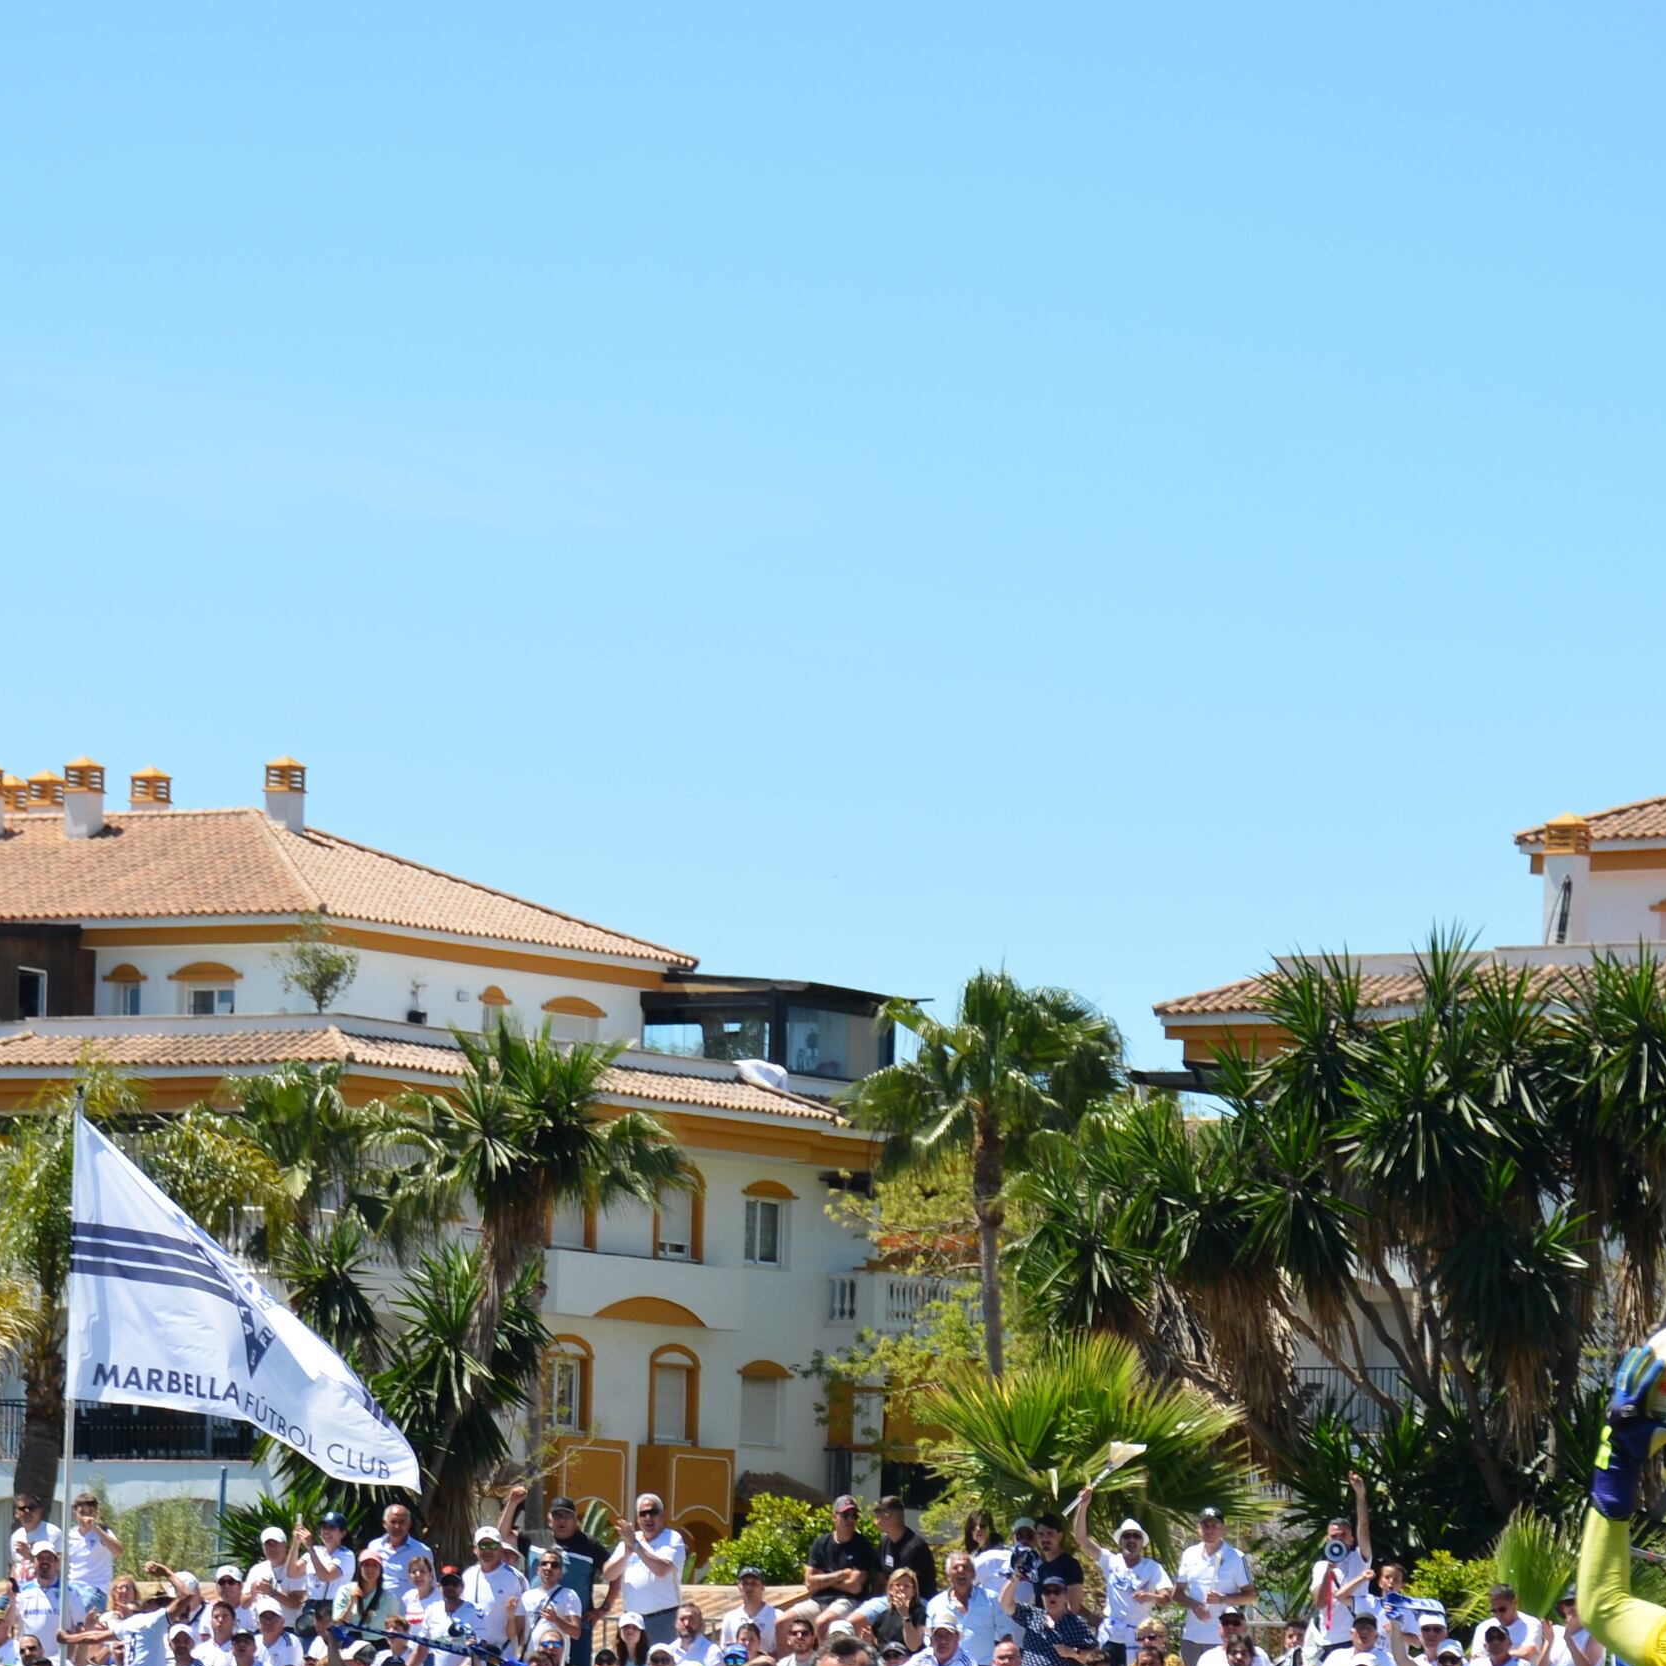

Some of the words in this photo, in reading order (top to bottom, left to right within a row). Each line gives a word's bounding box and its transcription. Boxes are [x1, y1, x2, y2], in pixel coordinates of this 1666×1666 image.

[92, 1362, 241, 1408] MARBELLA
[243, 1392, 319, 1457] FÚTBOL
[327, 1443, 392, 1481] CLUB
